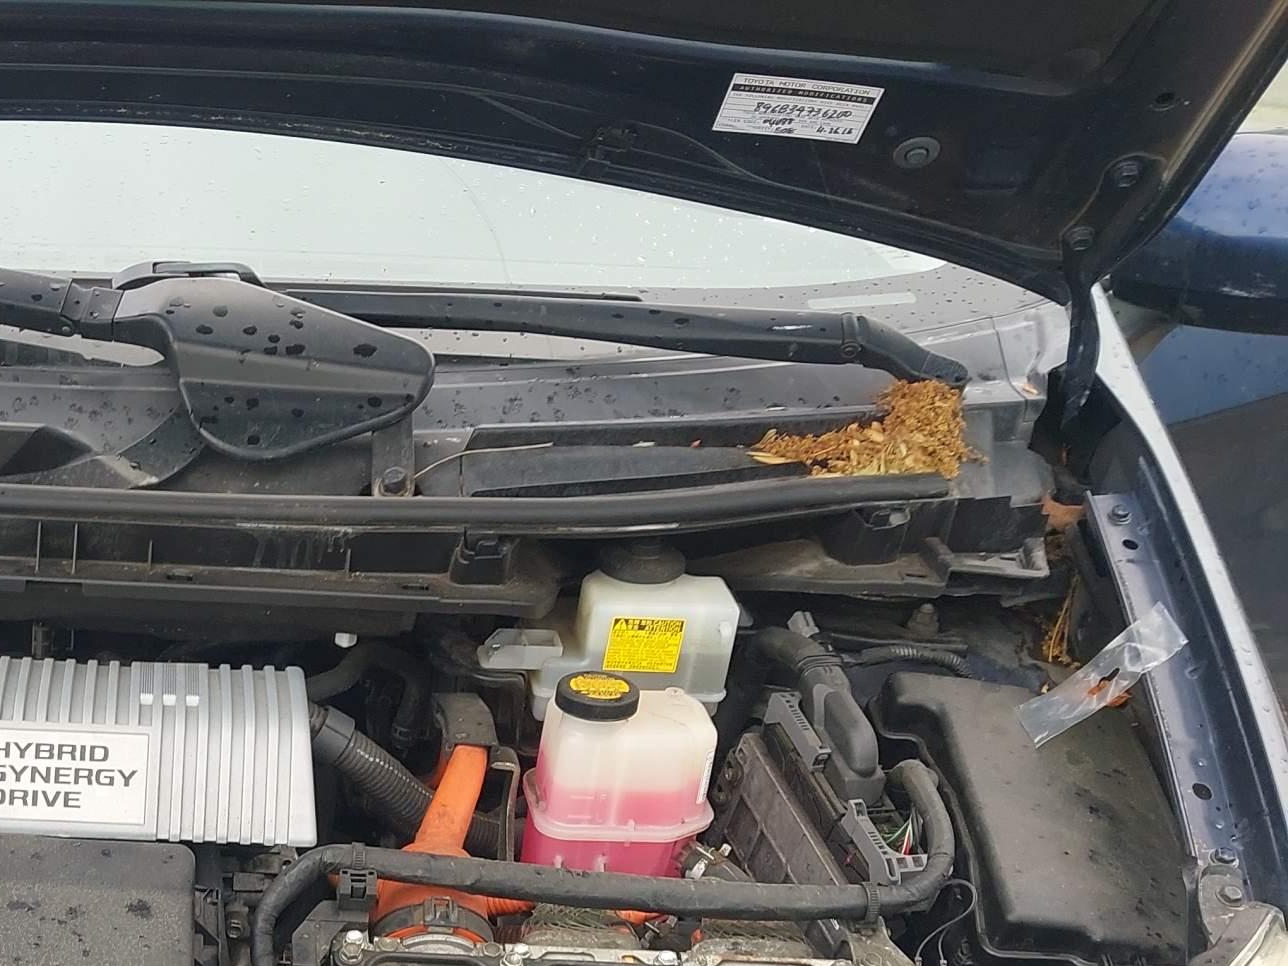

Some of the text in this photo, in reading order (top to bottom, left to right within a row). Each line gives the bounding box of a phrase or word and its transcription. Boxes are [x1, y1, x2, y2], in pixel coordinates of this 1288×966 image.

[738, 85, 793, 95] AUTHORIZED
[798, 90, 869, 104] MODIFICATIONS
[744, 77, 872, 96] TOYOTA MOTOR CORPORATION
